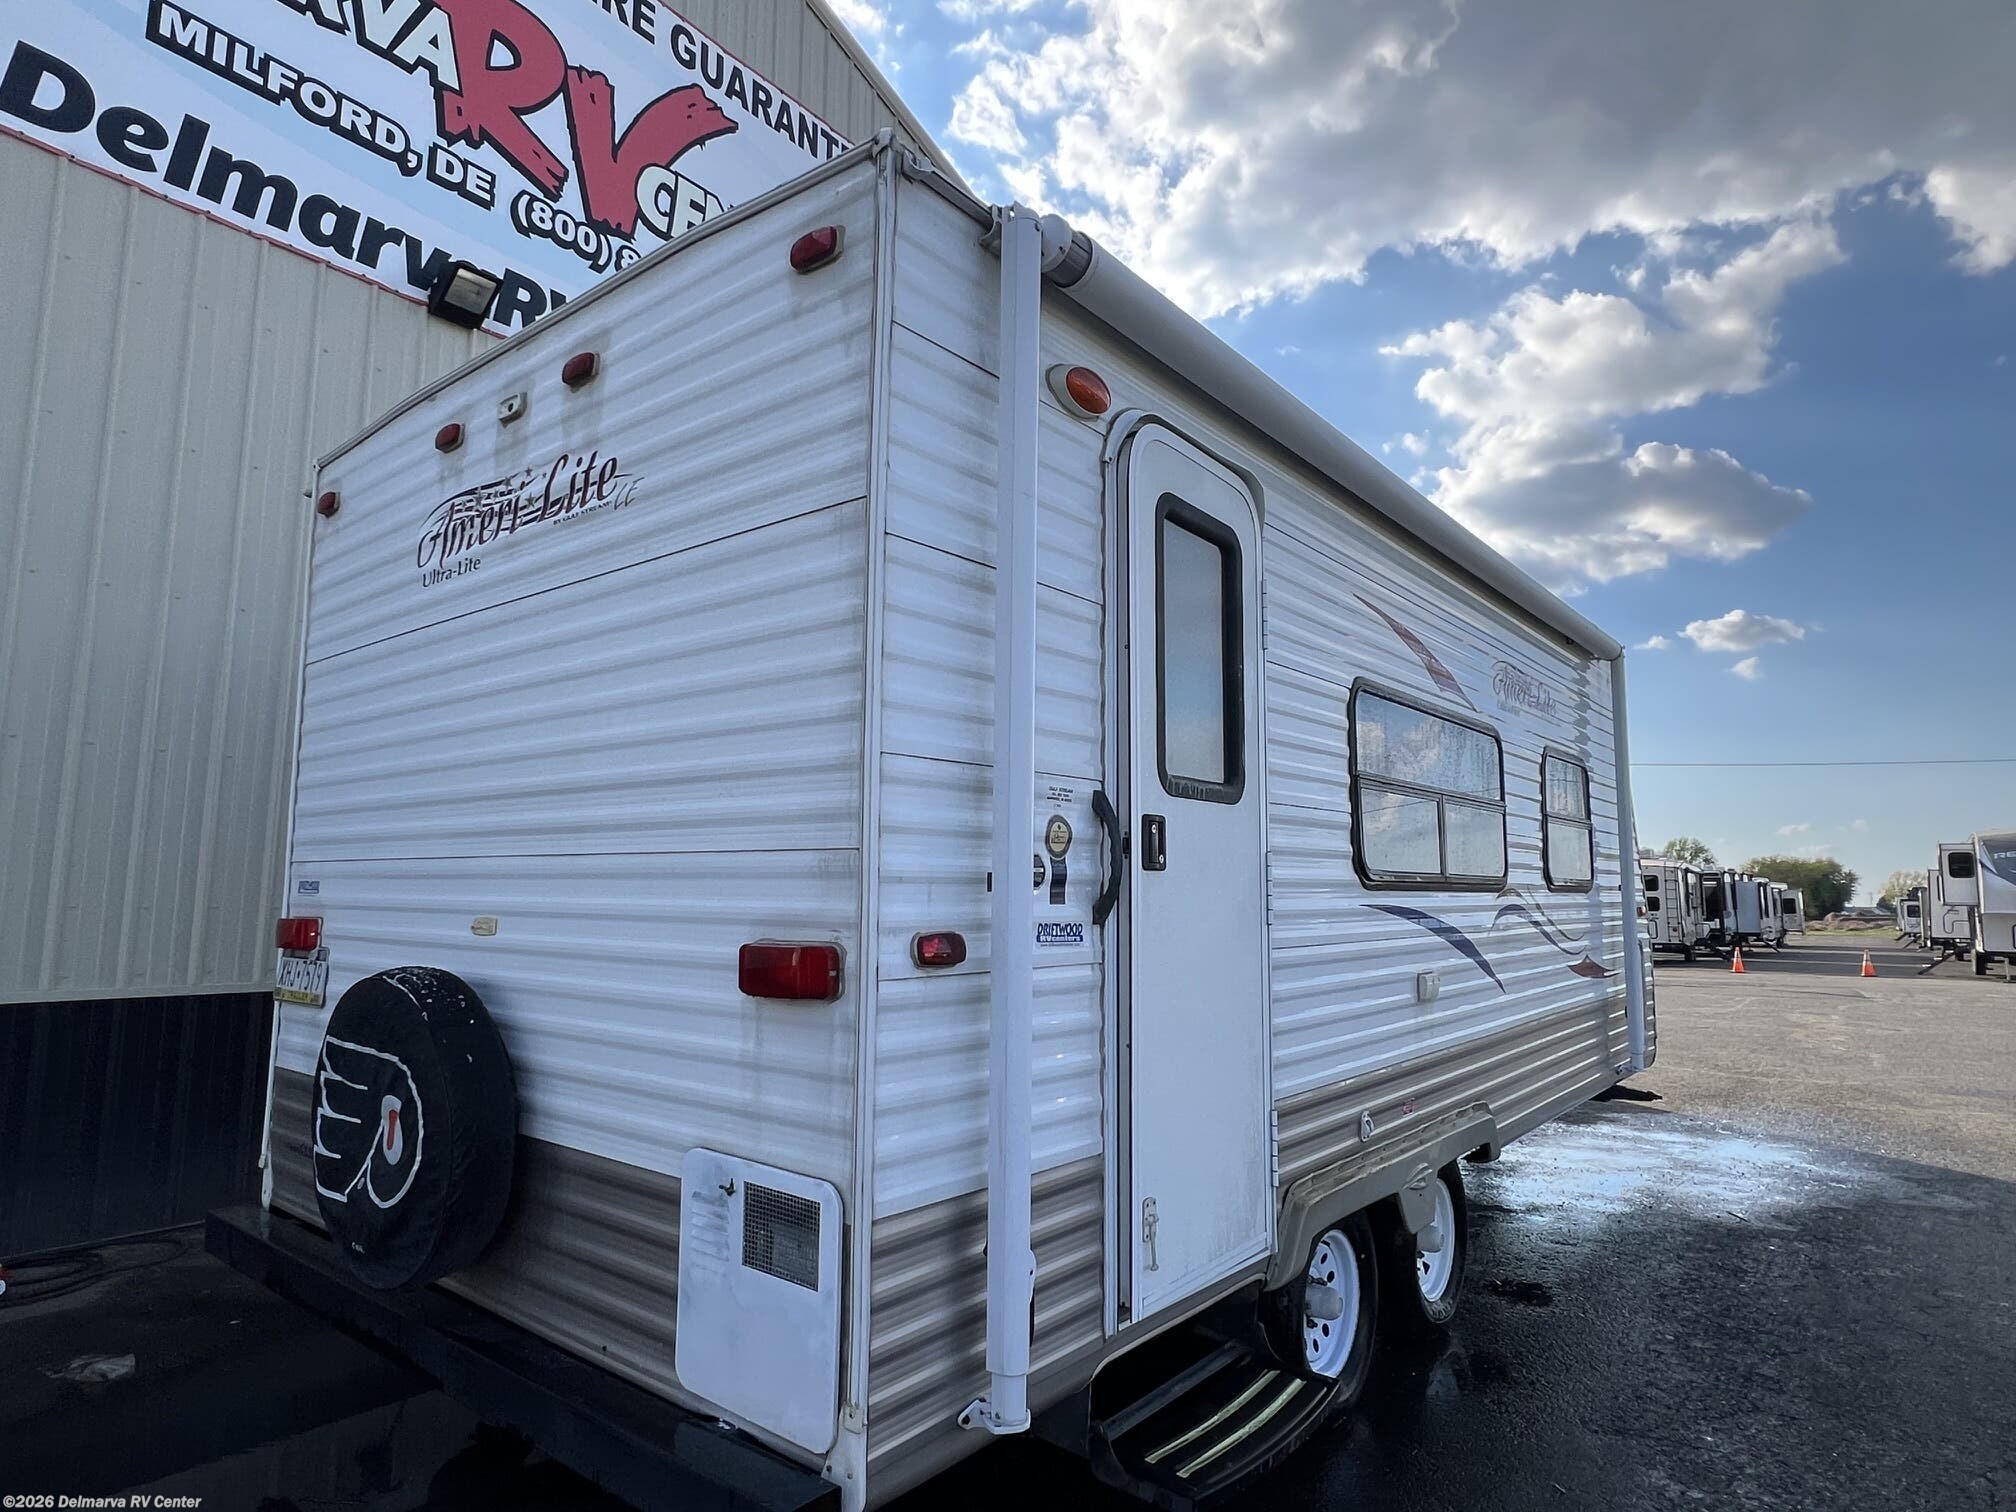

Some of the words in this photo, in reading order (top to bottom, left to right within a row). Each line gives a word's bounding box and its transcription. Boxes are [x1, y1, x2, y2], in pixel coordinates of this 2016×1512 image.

[147, 2, 424, 178] MILFORD,
[427, 142, 496, 210] DE
[511, 190, 613, 273] (800)
[440, 0, 739, 242] RV
[422, 556, 481, 588] Ultra-Lite
[1037, 922, 1083, 937] DRIFTWOOD
